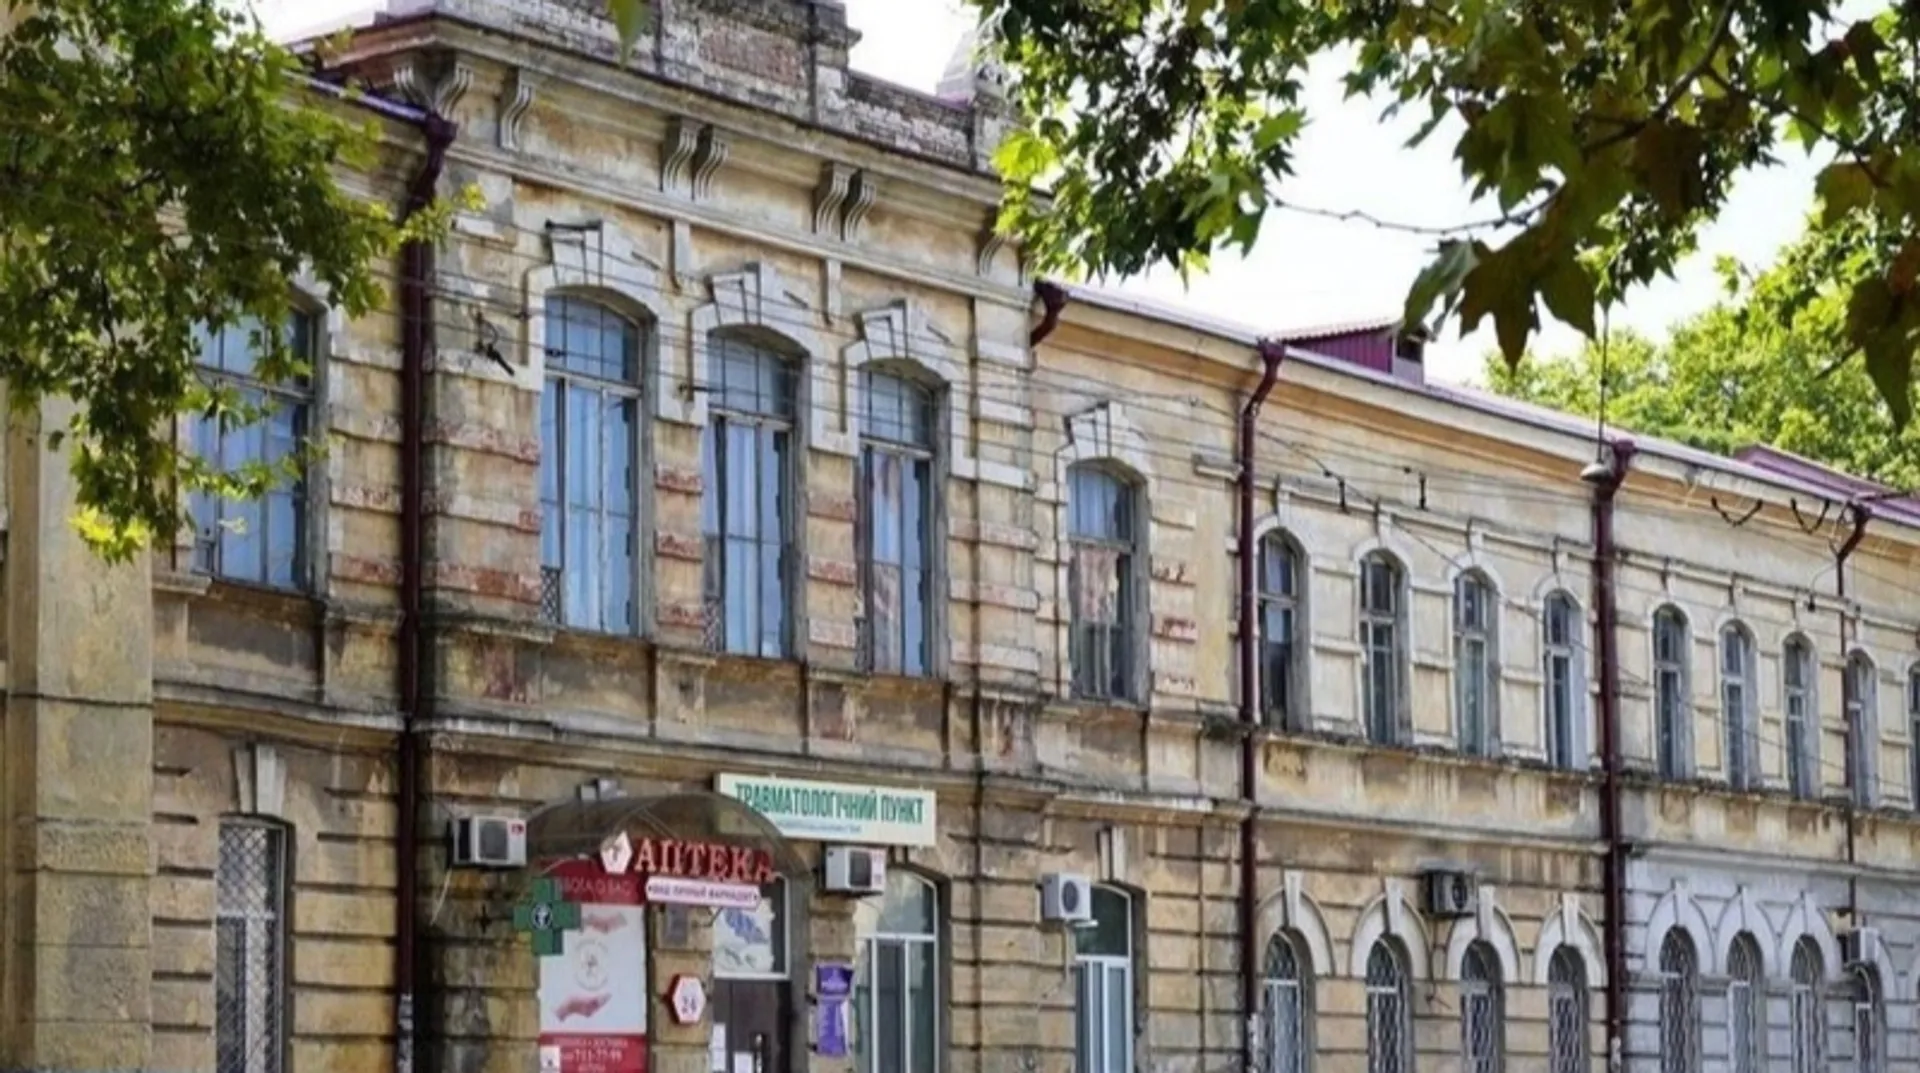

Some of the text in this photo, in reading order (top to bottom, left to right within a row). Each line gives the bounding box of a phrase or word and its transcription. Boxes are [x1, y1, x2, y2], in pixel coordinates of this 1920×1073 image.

[880, 793, 924, 825] ПУНКТ
[634, 836, 776, 884] АПТЕКА
[681, 995, 698, 1014] 24
